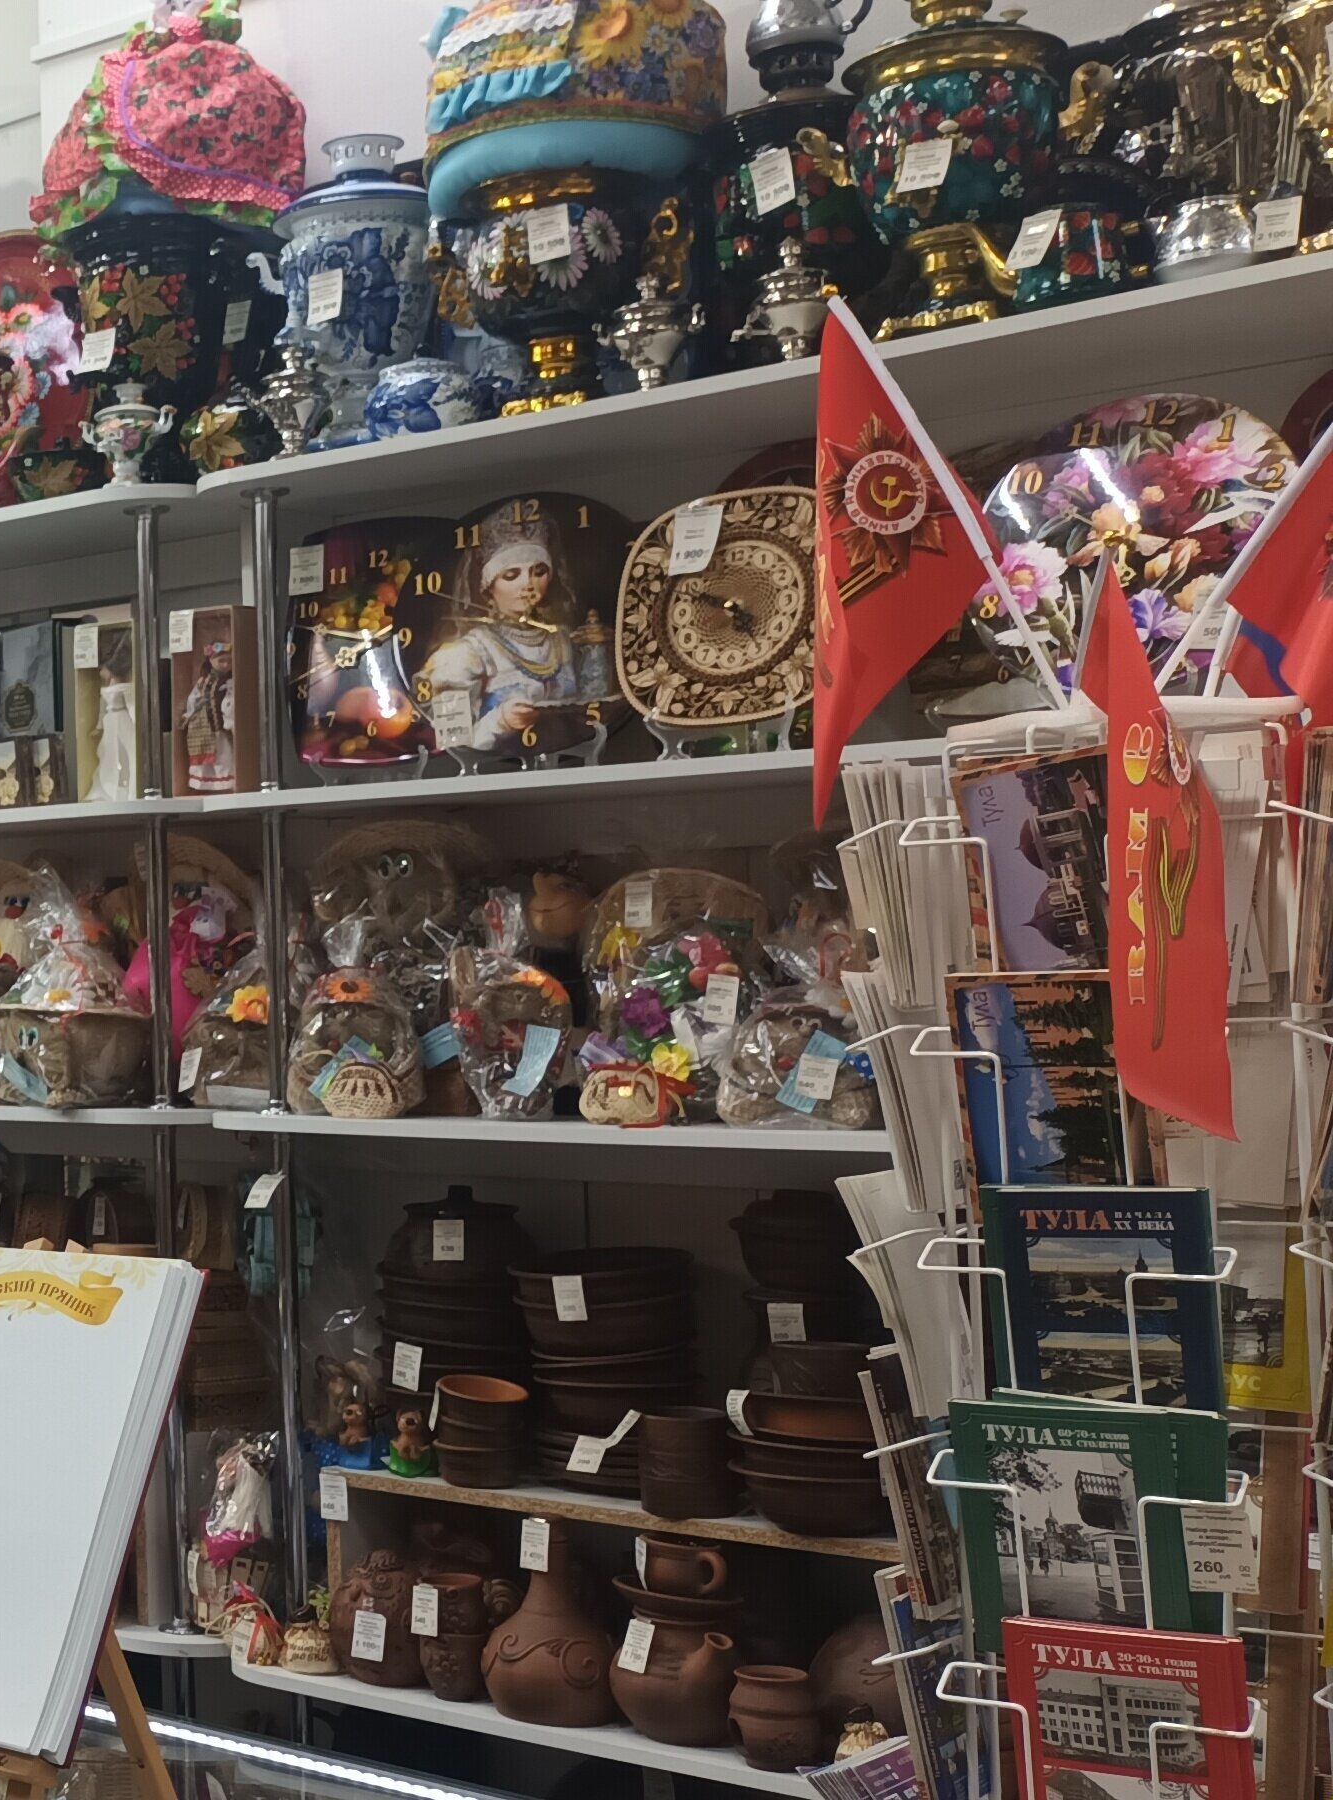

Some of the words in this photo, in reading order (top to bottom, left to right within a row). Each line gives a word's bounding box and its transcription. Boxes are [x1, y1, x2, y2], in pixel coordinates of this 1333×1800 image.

[1143, 400, 1180, 427] 12
[1068, 422, 1102, 447] 11
[1217, 414, 1237, 443] 1
[1009, 470, 1043, 495] 10
[1262, 462, 1287, 489] 2
[511, 498, 541, 525] 12
[577, 505, 590, 530] 1
[454, 523, 482, 550] 11
[368, 549, 389, 569] 12
[731, 550, 745, 562] 12
[329, 566, 348, 586] 11
[414, 571, 443, 596] 10
[777, 568, 789, 581] 2
[299, 600, 319, 619] 10
[783, 593, 793, 607] 3
[979, 594, 1000, 620] 8
[397, 627, 413, 649] 9
[773, 620, 784, 633] 4
[701, 647, 711, 662] 7
[417, 680, 431, 703] 8
[585, 701, 602, 726] 5
[367, 720, 378, 738] 6
[522, 725, 538, 748] 6
[981, 785, 1004, 828] Тула
[970, 991, 996, 1032] Тула
[1019, 1209, 1111, 1231] ТУЛА
[1113, 1220, 1132, 1231] XX
[1137, 1220, 1175, 1231] ВЕКА
[1114, 1211, 1172, 1219] НАЧАЛА
[39, 1282, 97, 1318] ПРЯНИК
[981, 1423, 1057, 1446] ТУЛА
[1076, 1439, 1130, 1450] СТОЛЕТИЯ
[901, 1489, 917, 1525] КРЕМЛЬ
[1193, 1560, 1223, 1574] 260
[1031, 1643, 1116, 1671] ТУЛА
[1116, 1652, 1161, 1665] 20-30-х
[1138, 1666, 1198, 1679] СТОЛЕТИЯ
